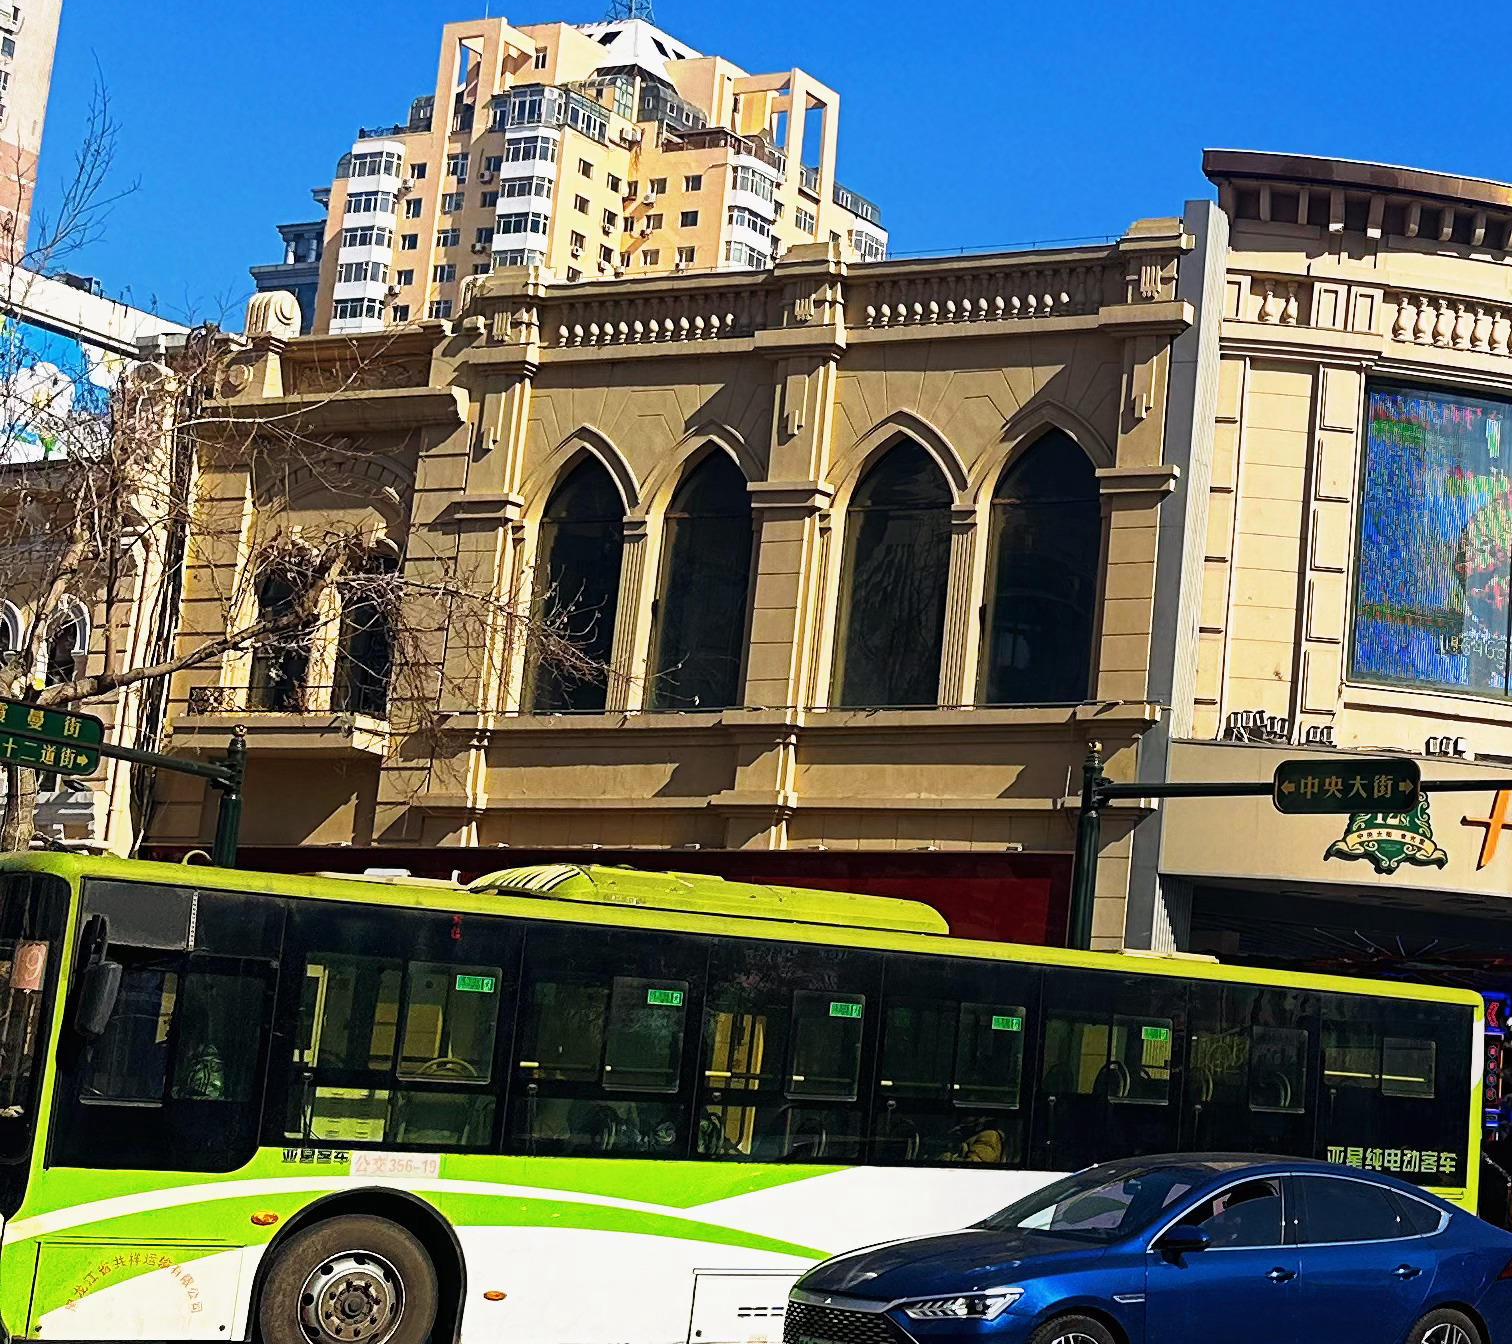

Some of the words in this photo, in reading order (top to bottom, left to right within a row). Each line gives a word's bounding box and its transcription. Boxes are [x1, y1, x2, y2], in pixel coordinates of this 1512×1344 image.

[2, 737, 76, 769] 十二道街
[1299, 775, 1394, 800] 中央大街
[356, 1155, 437, 1174] 公交356-19
[1327, 1146, 1457, 1173] 亚星纯电动客车
